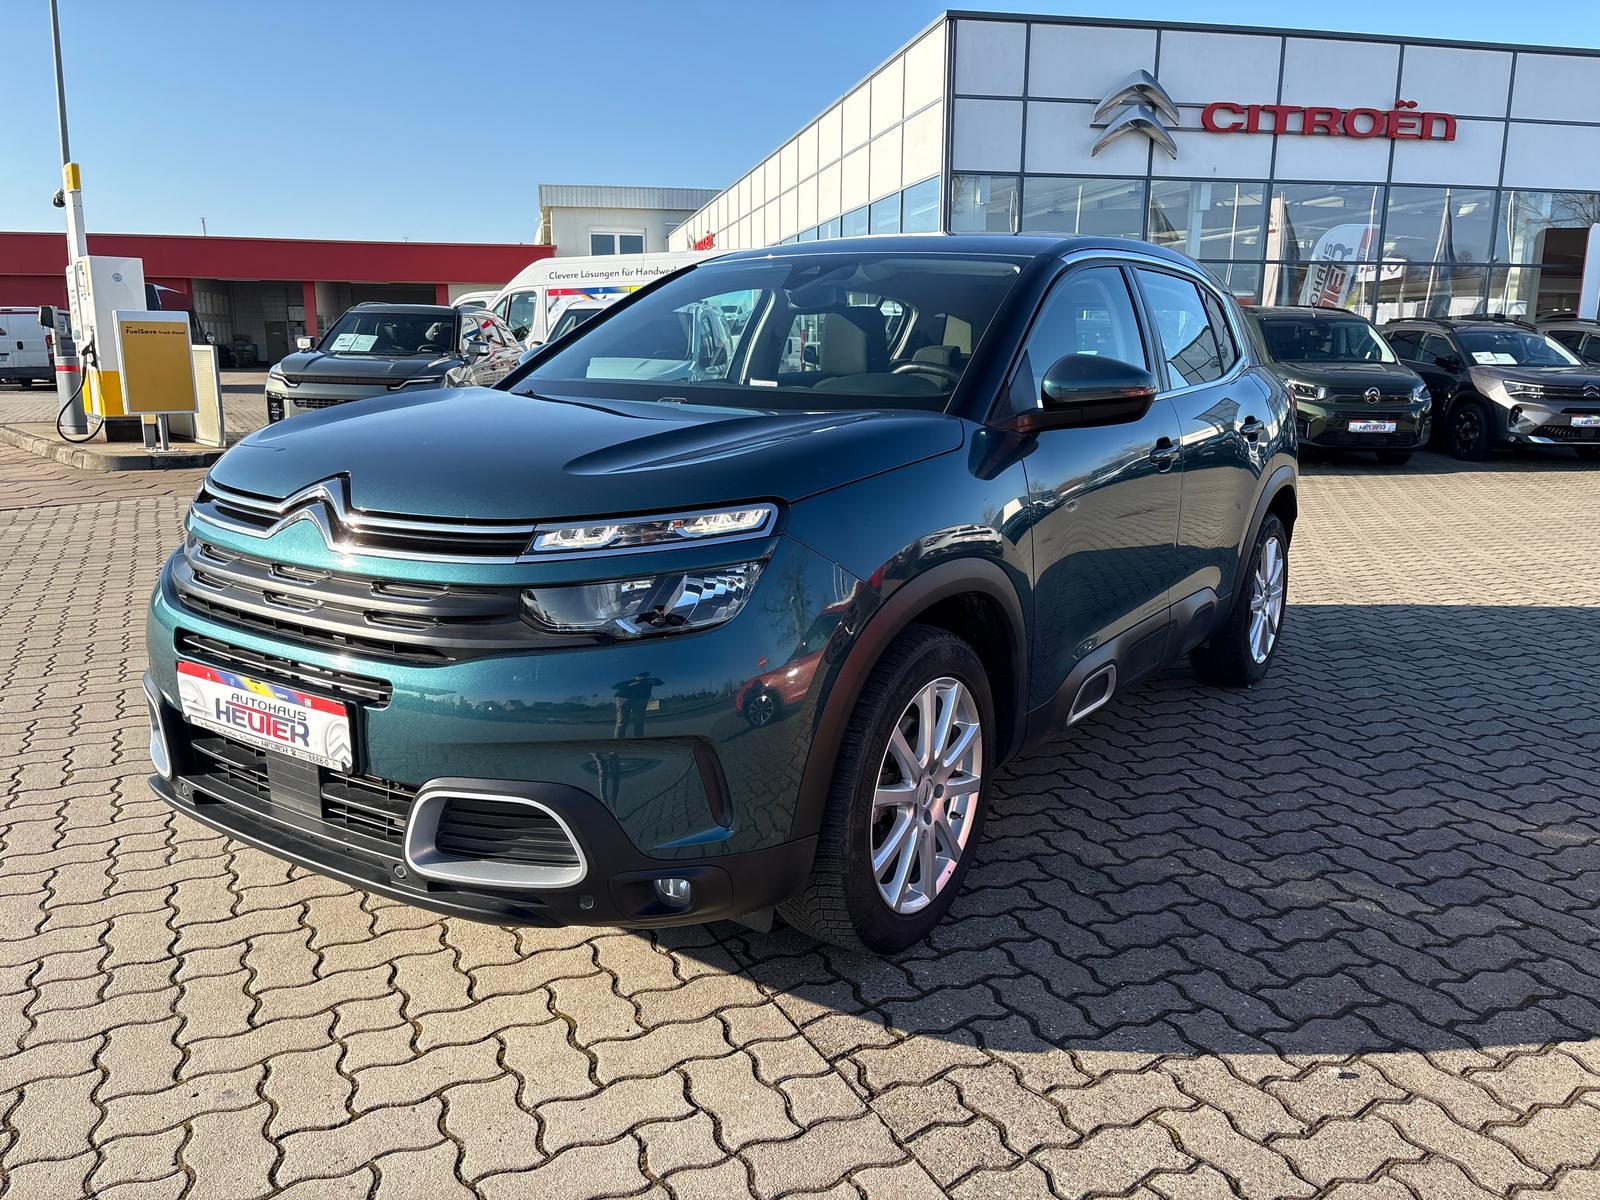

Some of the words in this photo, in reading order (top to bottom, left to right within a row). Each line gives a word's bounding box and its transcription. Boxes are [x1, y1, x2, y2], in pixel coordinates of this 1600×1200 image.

[549, 271, 579, 280] Clevere
[581, 270, 620, 280] Lösungen
[621, 268, 635, 277] für
[231, 692, 307, 722] AUTOHAUS
[215, 697, 310, 748] HEUTER
